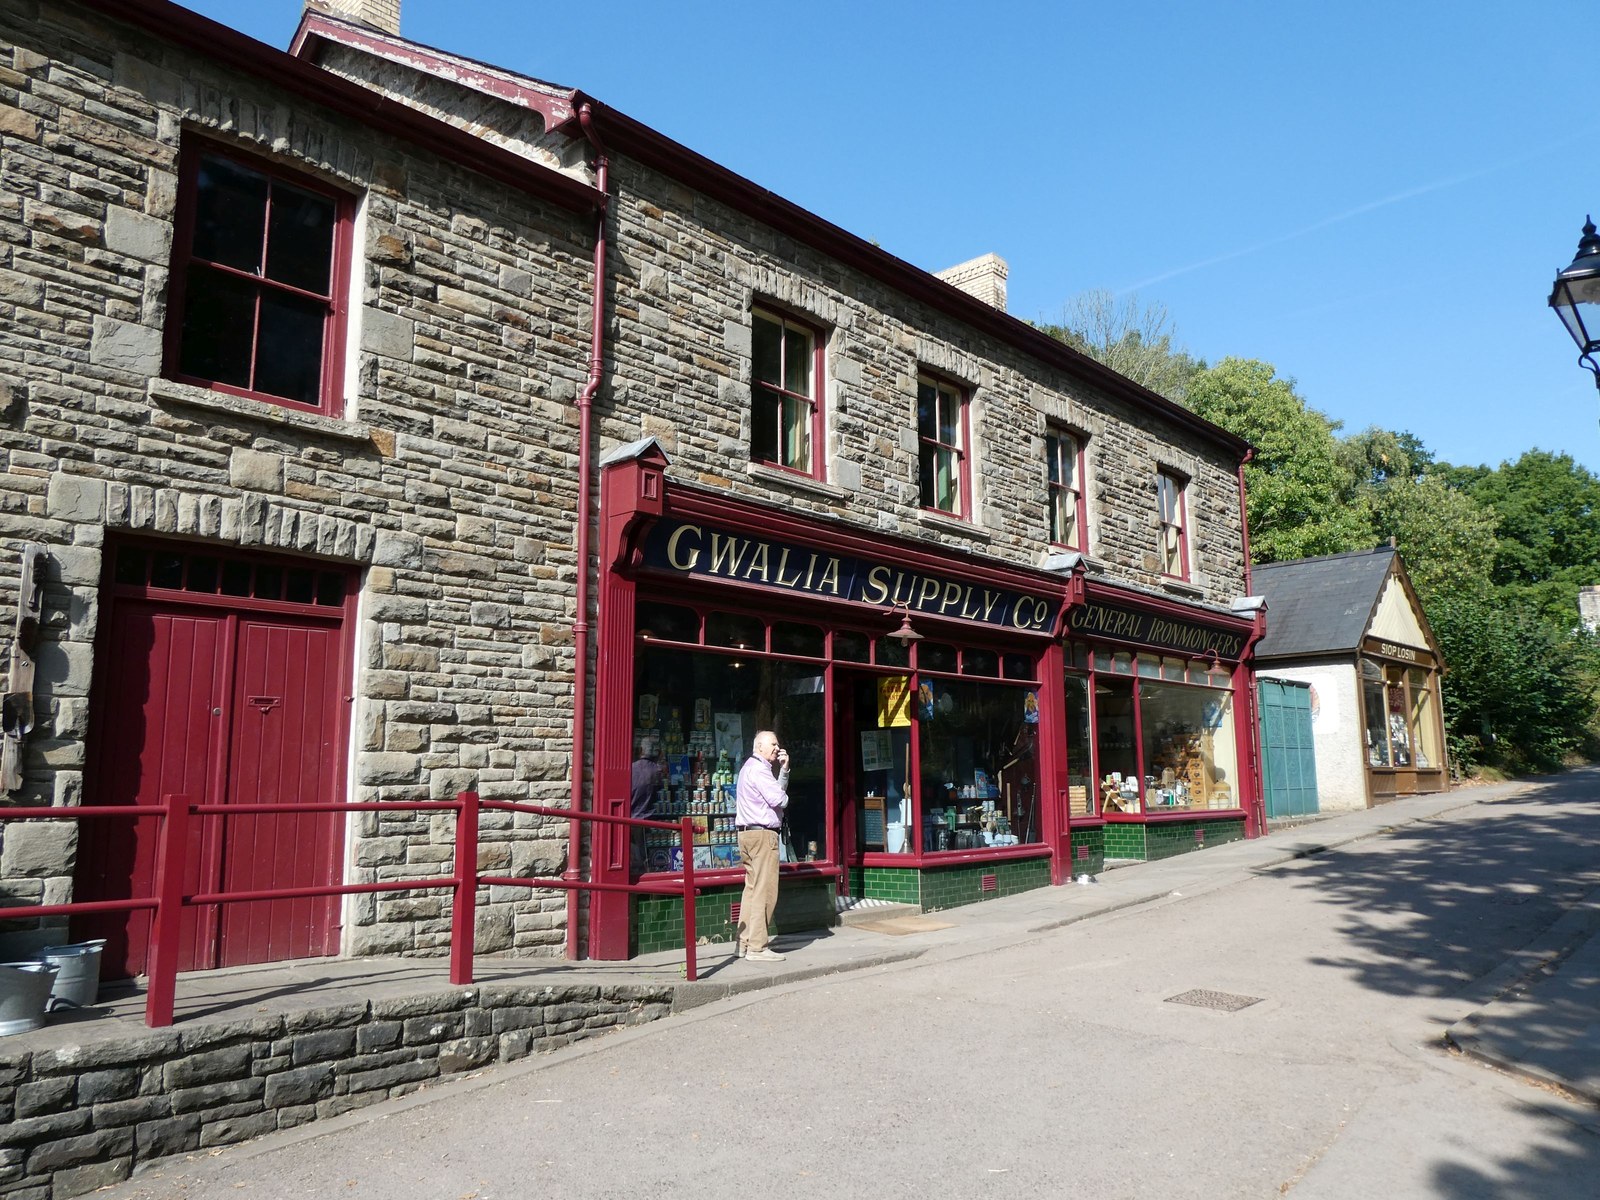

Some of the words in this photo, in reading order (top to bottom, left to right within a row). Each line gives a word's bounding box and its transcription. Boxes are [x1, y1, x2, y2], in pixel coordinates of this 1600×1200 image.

[667, 524, 840, 595] GWALIA
[861, 566, 1001, 621] SUPPLY
[1072, 603, 1142, 638] GENERAL
[1147, 617, 1241, 656] IRONMONGERS
[1381, 643, 1397, 656] SIOP
